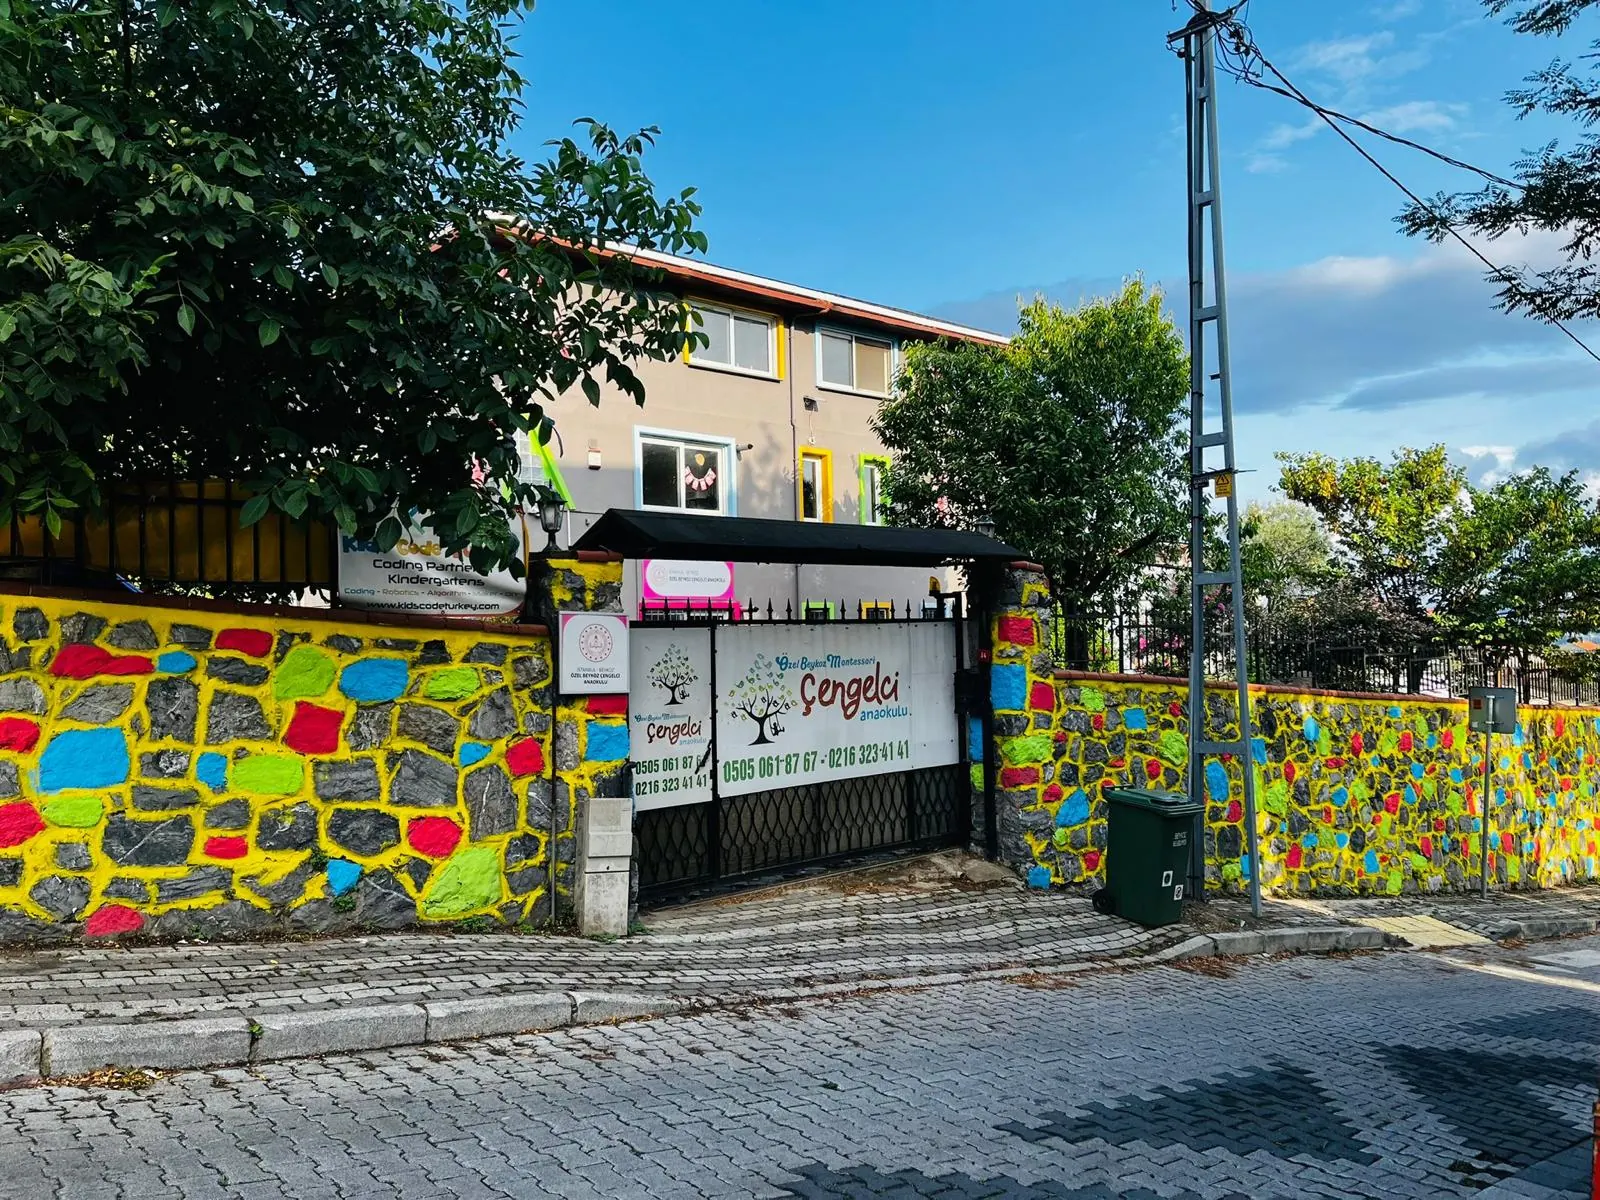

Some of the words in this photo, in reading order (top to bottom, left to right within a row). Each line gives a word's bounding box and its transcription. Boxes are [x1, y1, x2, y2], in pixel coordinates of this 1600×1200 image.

[396, 538, 441, 556] Code
[373, 559, 423, 571] Coding
[426, 561, 475, 573] Partne
[388, 574, 485, 587] Kindergartens
[344, 587, 376, 596] Coding
[382, 588, 419, 596] Robotics
[366, 601, 500, 611] www.kidscodeturkey.com
[775, 652, 800, 671] Özel
[800, 656, 827, 671] Beykoz
[826, 654, 876, 669] Montessori
[800, 661, 900, 720] Çengelci
[646, 715, 702, 745] Çengelci
[635, 759, 660, 775] 0505
[662, 757, 679, 772] 061
[682, 755, 694, 769] 87
[723, 758, 755, 783] 0505
[803, 751, 818, 772] 67
[828, 745, 856, 769] 0216
[858, 743, 879, 765] 323
[881, 741, 894, 761] 41
[897, 739, 909, 760] 41
[635, 779, 660, 796] 0216
[662, 777, 680, 792] 323
[682, 775, 693, 790] 41
[696, 773, 707, 788] 41
